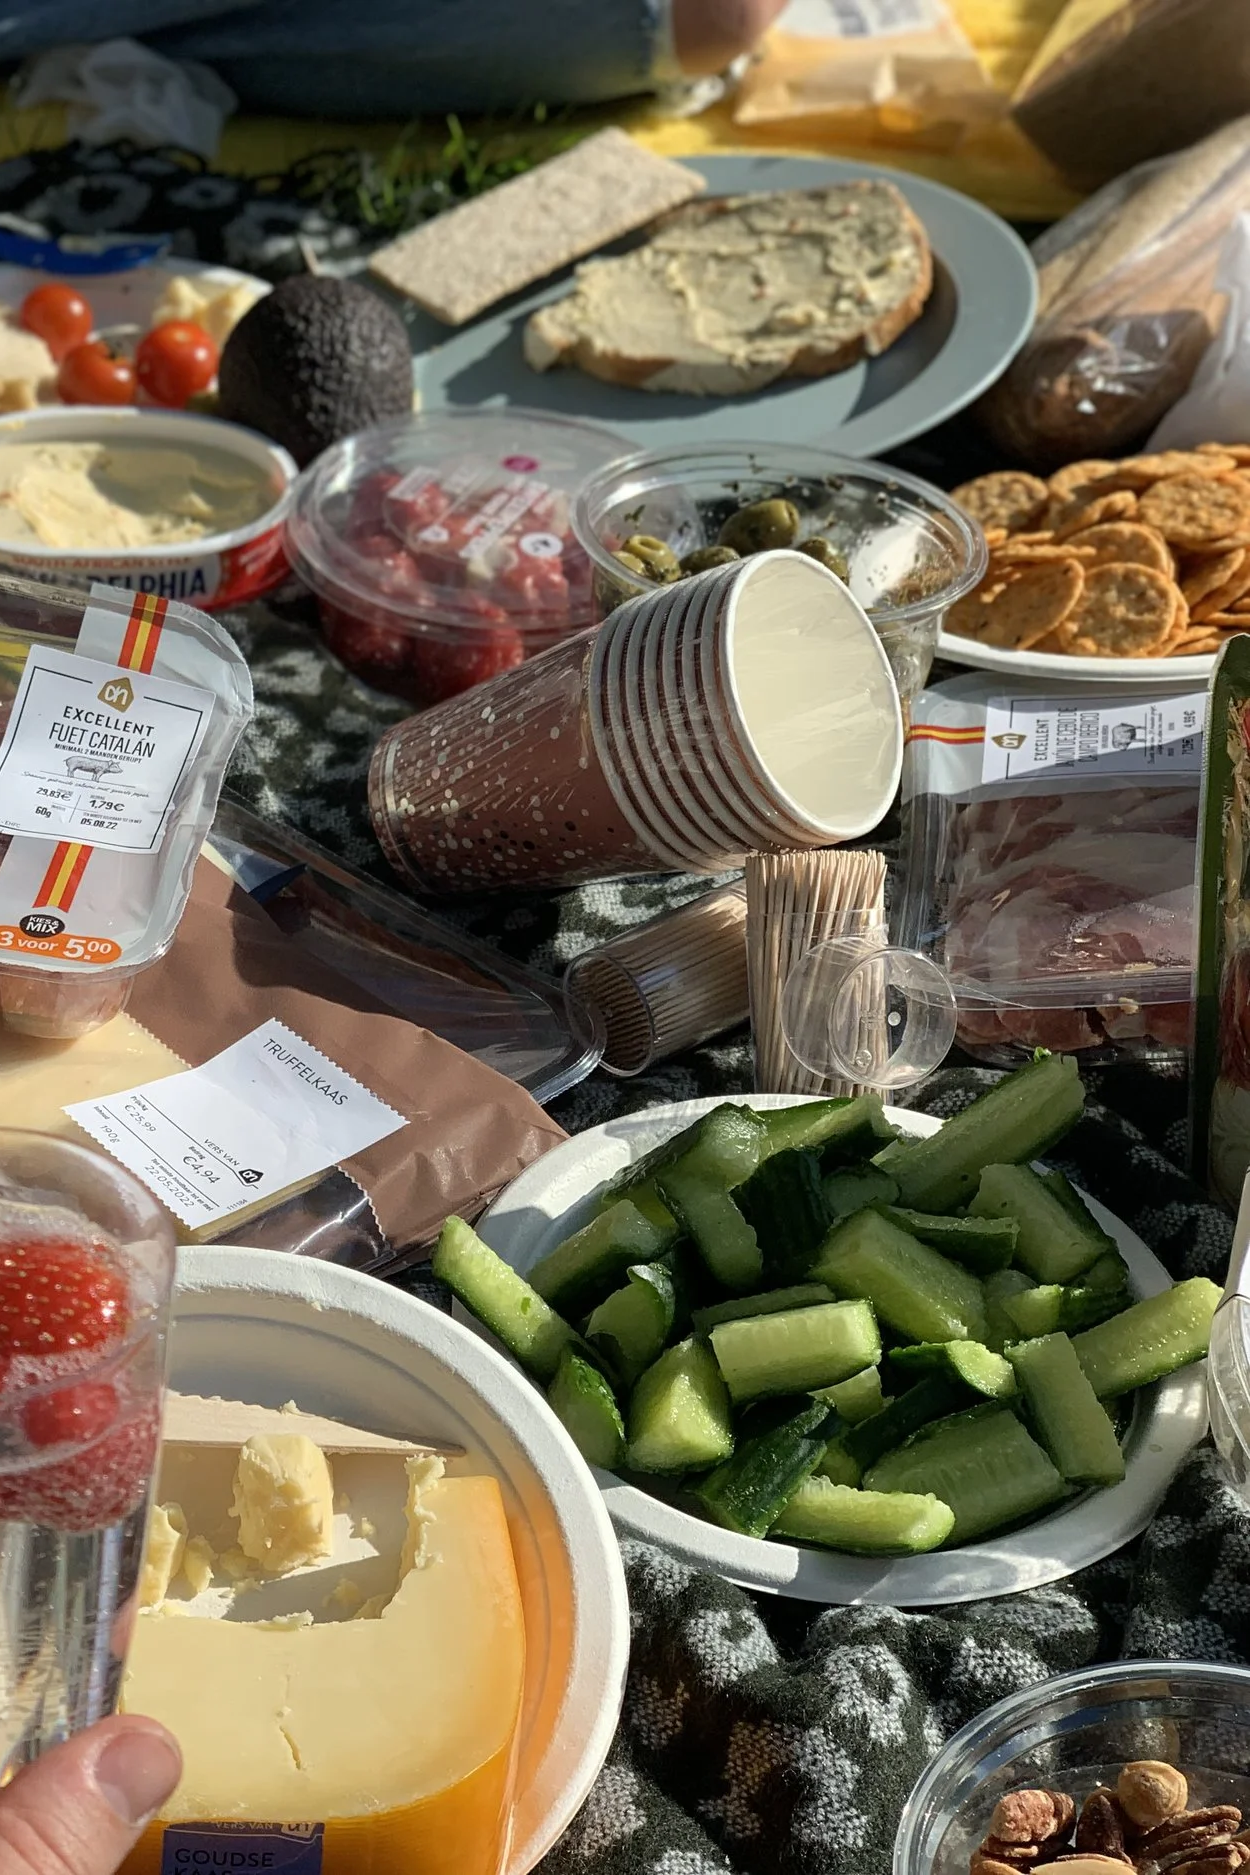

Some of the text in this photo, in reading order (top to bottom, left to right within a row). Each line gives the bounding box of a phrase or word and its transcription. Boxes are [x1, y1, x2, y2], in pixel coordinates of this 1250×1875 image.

[63, 705, 155, 738] EXCELLENT
[48, 722, 156, 758] FUET CATALÁN
[1034, 718, 1049, 762] EXCELLENT
[54, 743, 84, 755] MINIMAAL
[90, 749, 118, 760] MAANDEN
[35, 806, 51, 818] 60g
[89, 799, 125, 812] 1,79€
[26, 922, 60, 934] MIX
[17, 938, 60, 951] voor
[63, 938, 112, 960] 5.00
[261, 1038, 348, 1106] TRUFFELKAAS
[203, 1138, 223, 1159] VERS
[222, 1152, 240, 1167] VAN
[175, 1848, 276, 1868] GOUDSE
